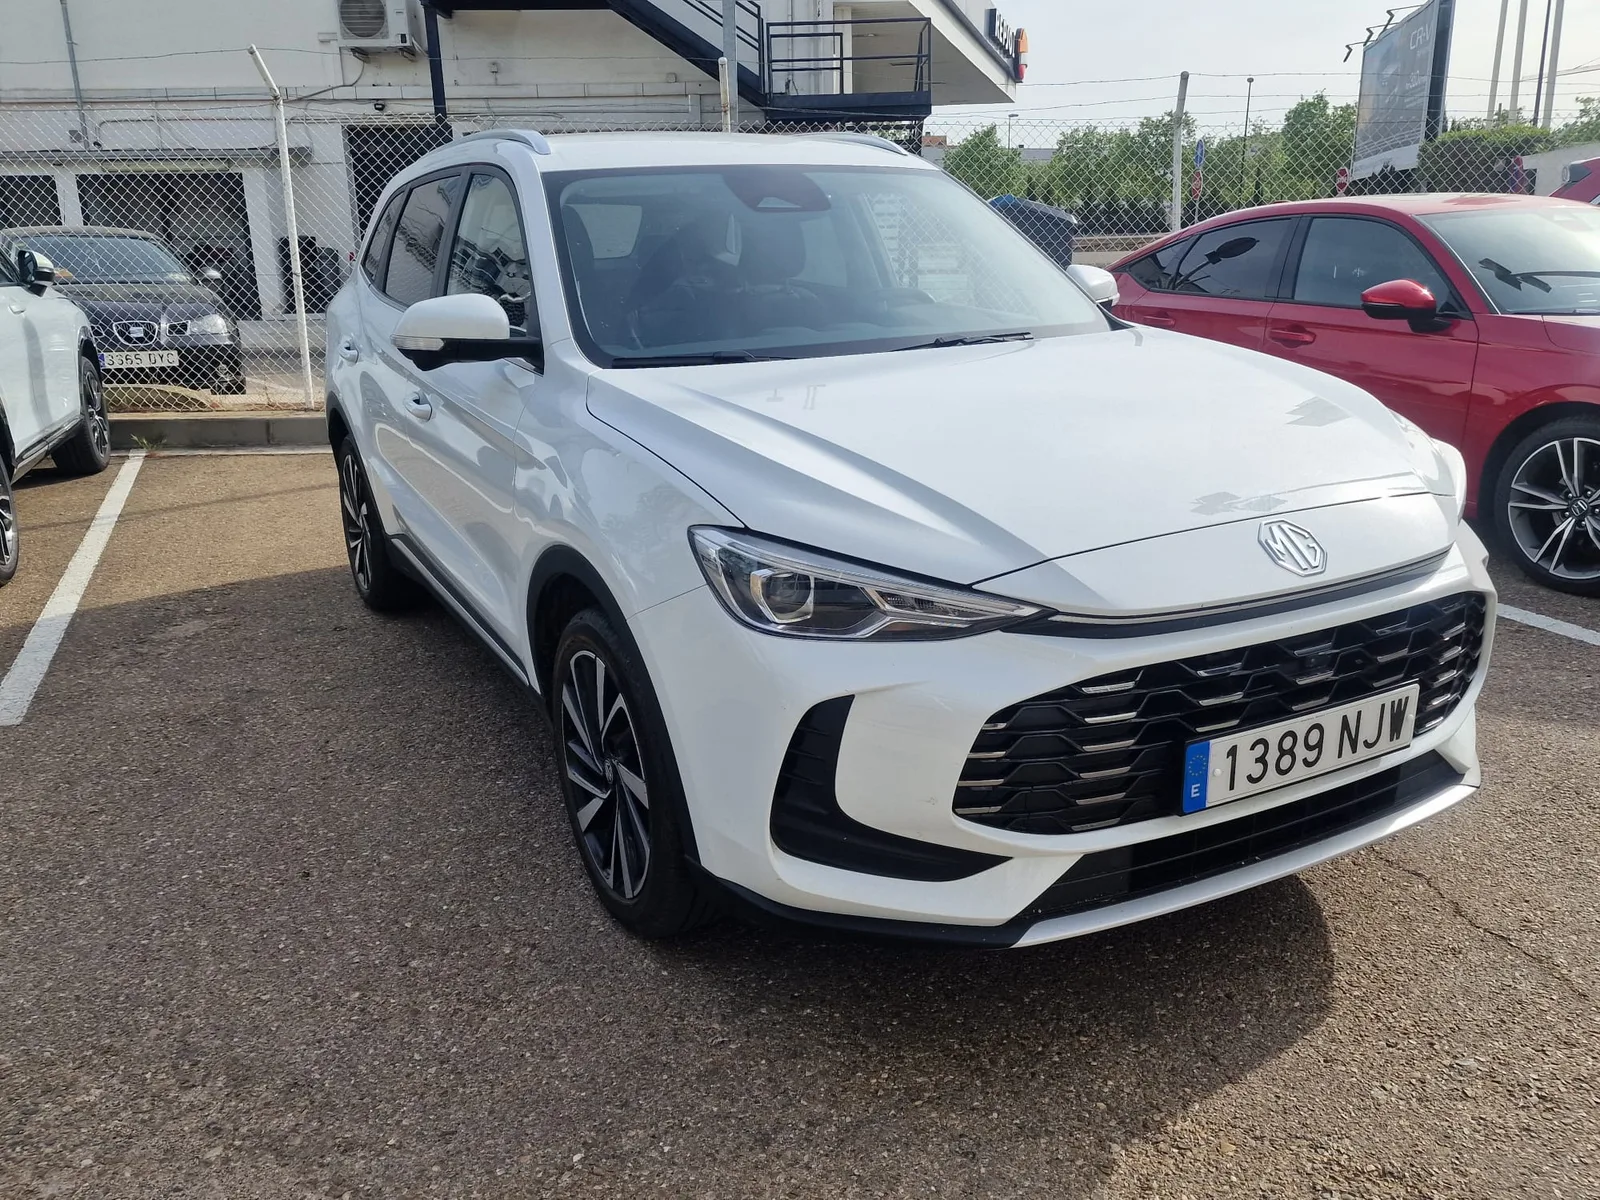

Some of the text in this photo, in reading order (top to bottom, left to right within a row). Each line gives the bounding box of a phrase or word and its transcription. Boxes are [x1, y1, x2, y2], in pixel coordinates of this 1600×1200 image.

[1264, 523, 1322, 571] MG
[1226, 696, 1409, 791] 1389 NJW
[1191, 784, 1200, 798] E
